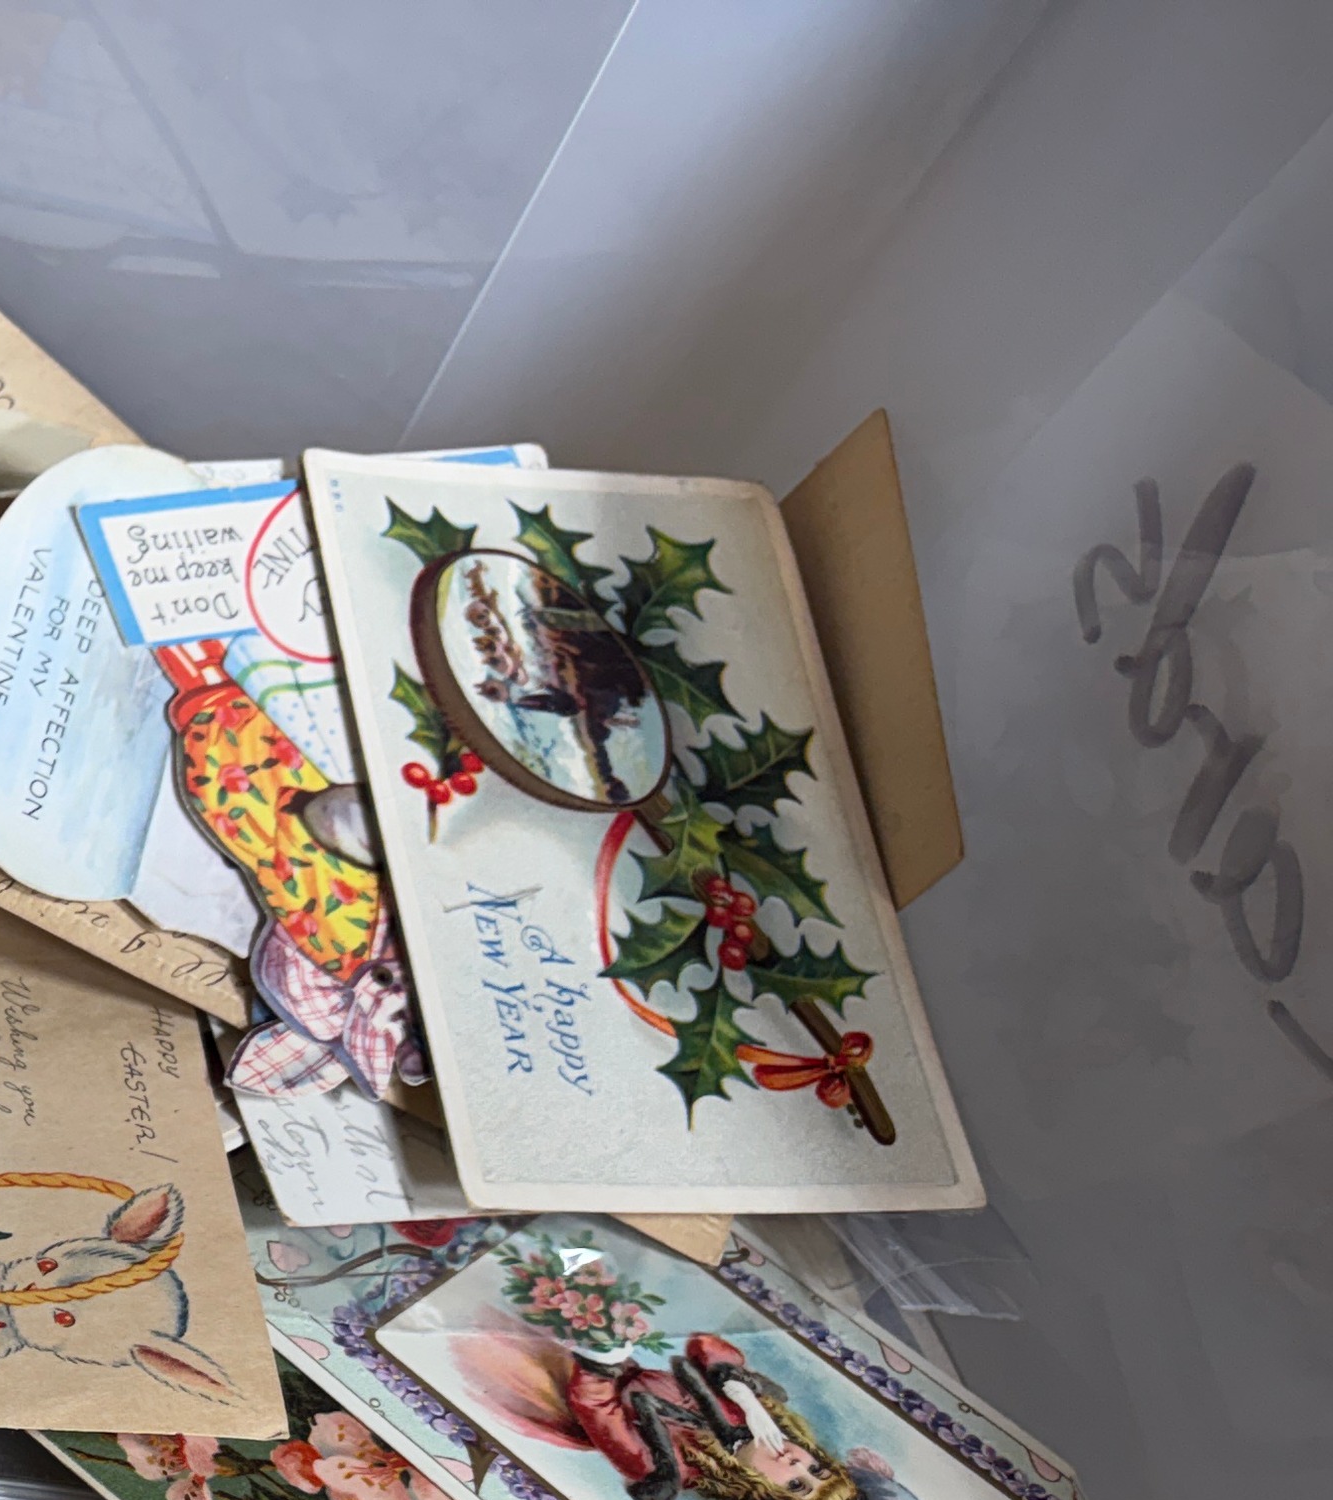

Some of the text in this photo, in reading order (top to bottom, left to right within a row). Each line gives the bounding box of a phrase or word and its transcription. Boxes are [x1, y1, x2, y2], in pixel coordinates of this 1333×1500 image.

[126, 524, 243, 565] waiting
[127, 555, 240, 587] keep me
[150, 591, 240, 626] Don't
[28, 594, 72, 698] FOR MY
[21, 673, 84, 822] AFFECTION
[464, 881, 540, 1077] NEW YEAR
[3, 1078, 36, 1128] you
